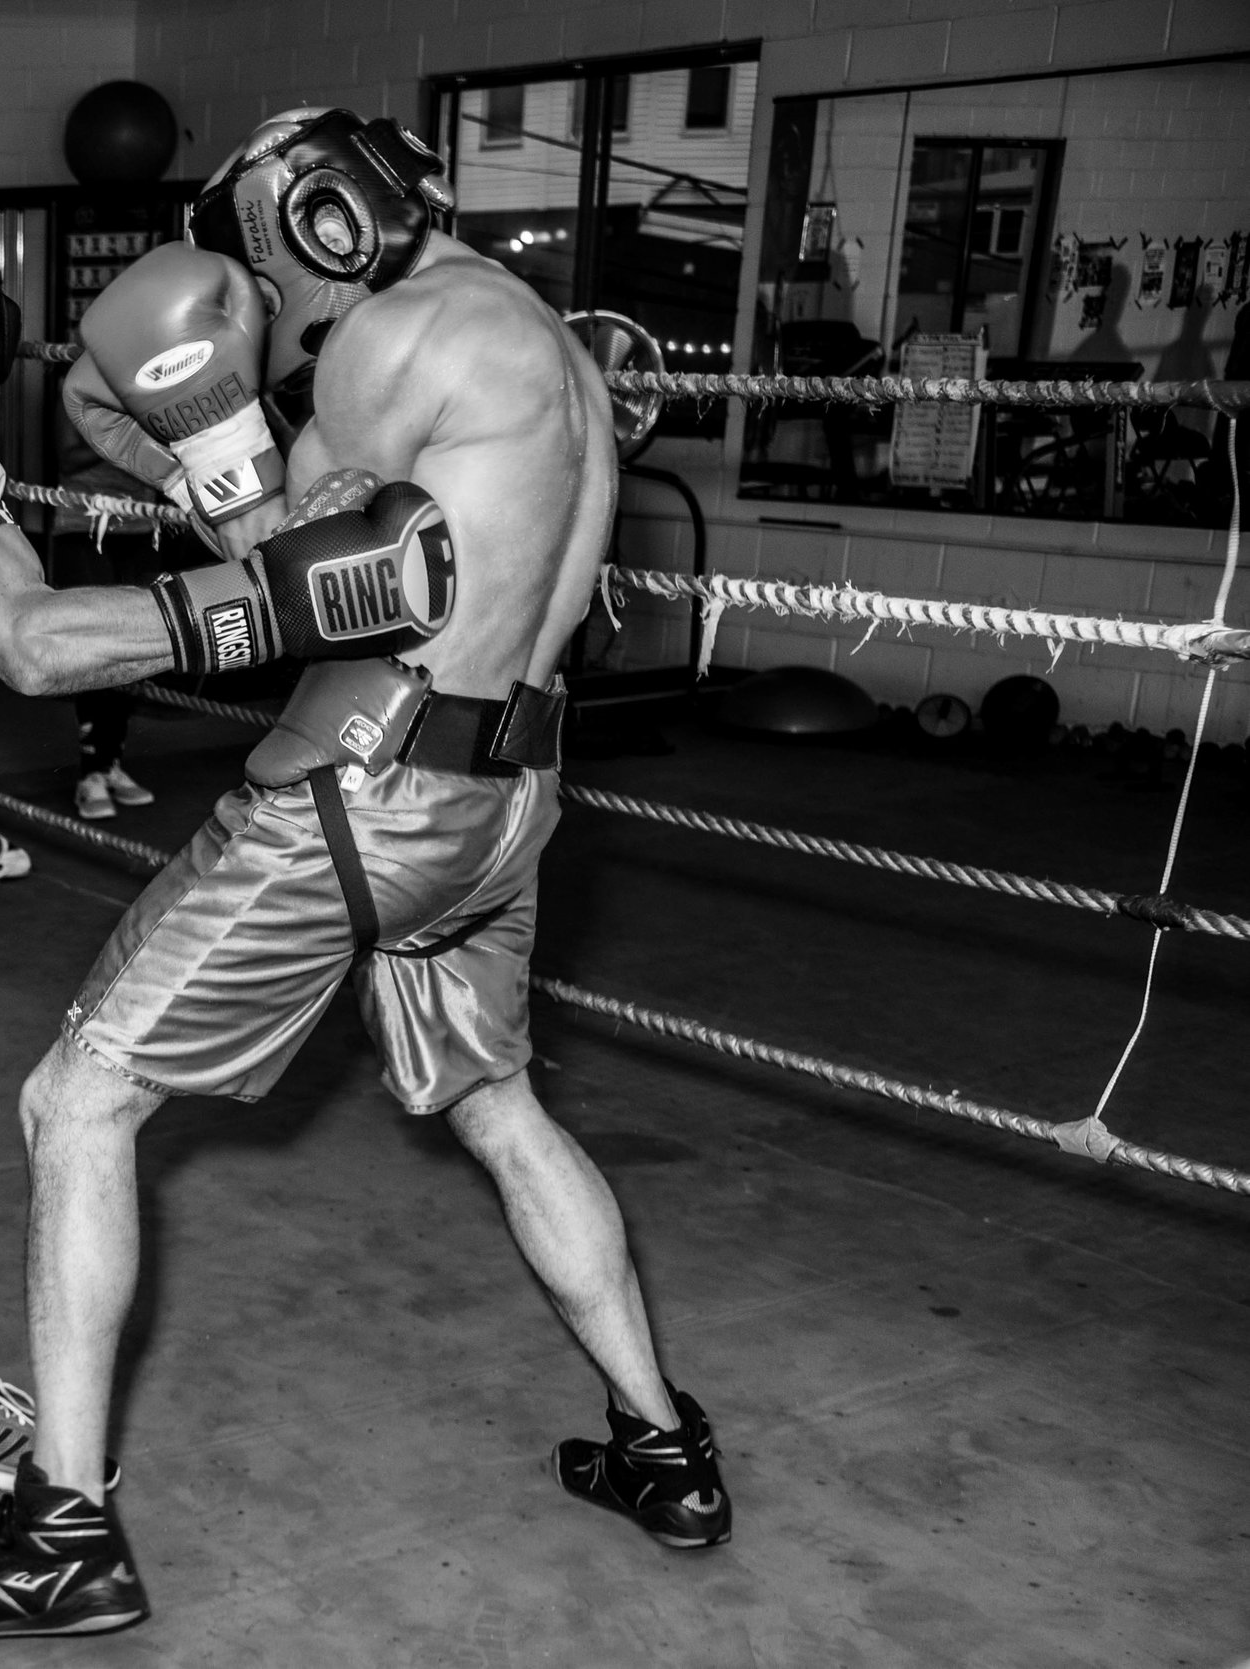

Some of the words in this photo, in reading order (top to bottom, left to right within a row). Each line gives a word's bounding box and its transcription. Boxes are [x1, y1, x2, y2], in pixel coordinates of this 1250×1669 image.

[241, 200, 267, 264] Farabi
[257, 200, 273, 256] PROTECTION
[143, 348, 206, 382] Winning
[147, 371, 258, 442] GABRIEL
[319, 557, 402, 633] RING
